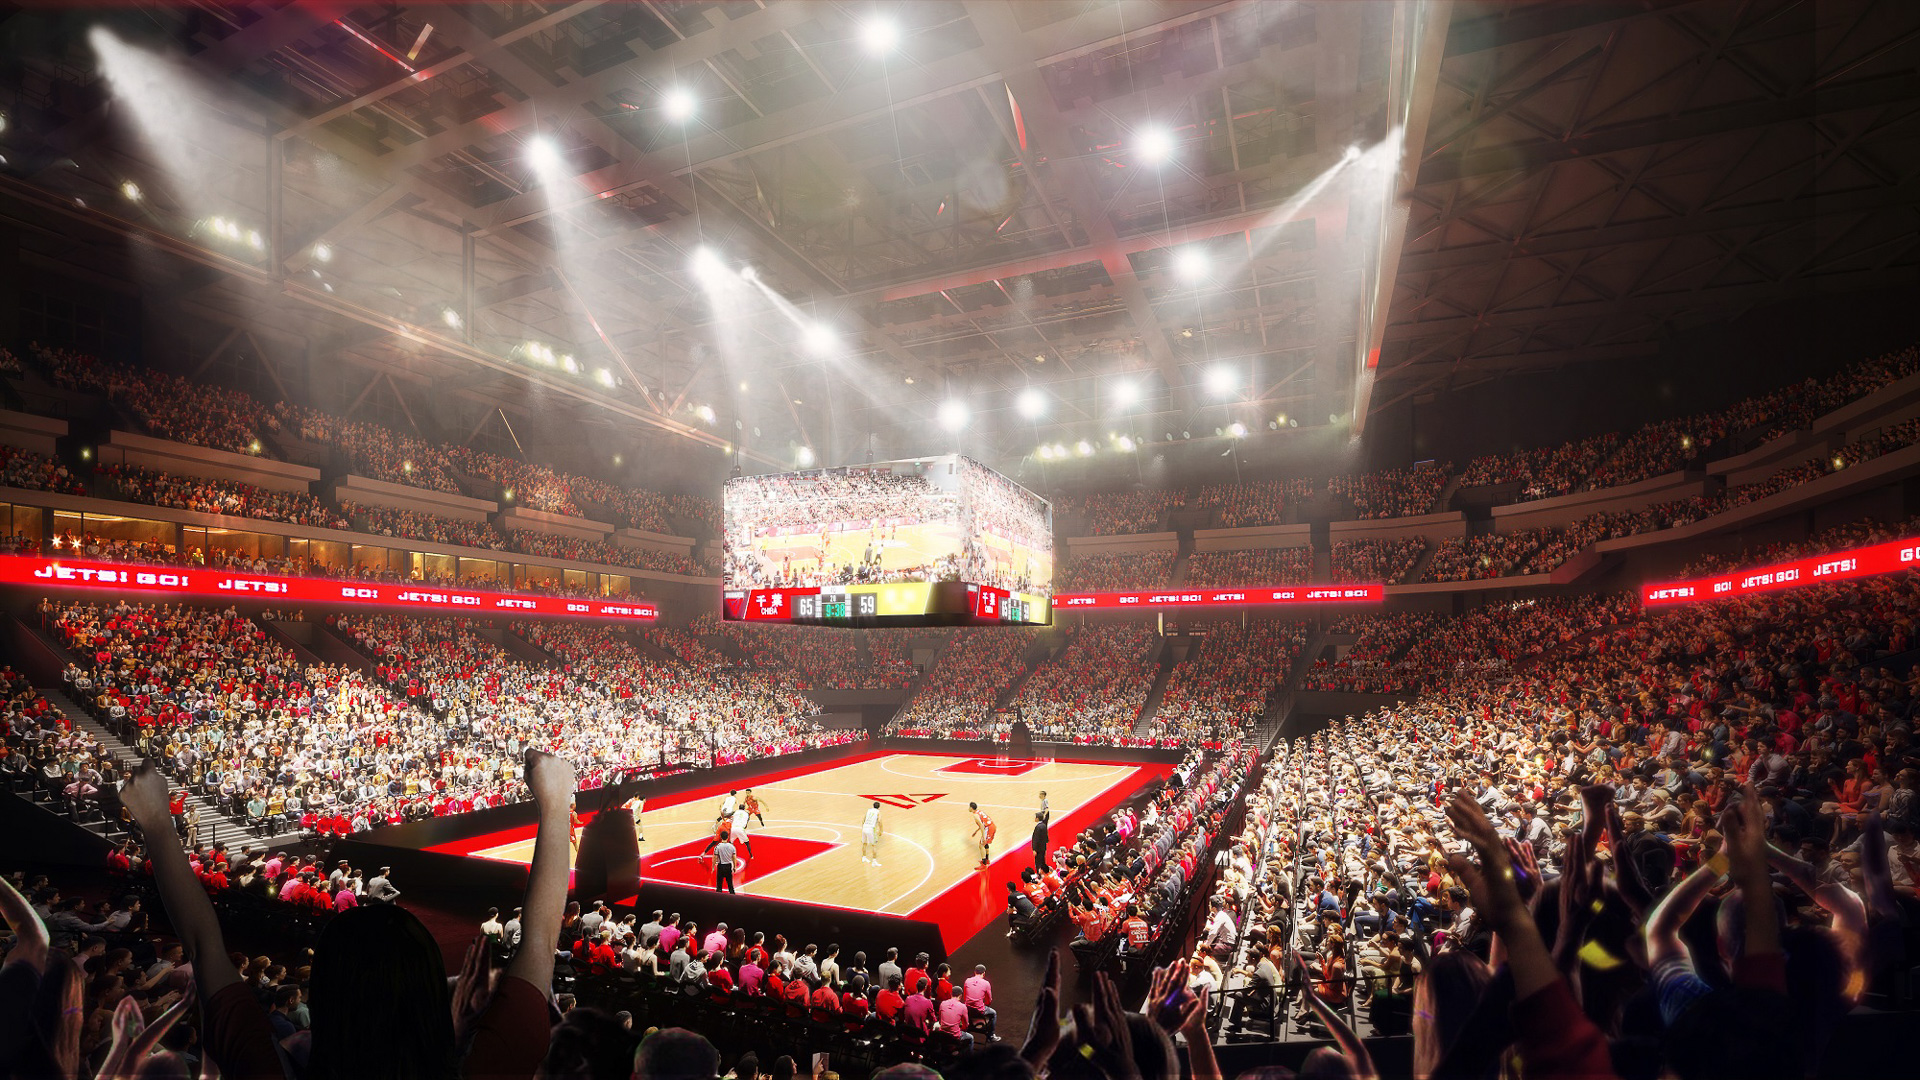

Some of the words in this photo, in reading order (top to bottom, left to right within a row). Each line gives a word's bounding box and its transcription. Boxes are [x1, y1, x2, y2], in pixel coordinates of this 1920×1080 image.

[1649, 587, 1694, 599] JETS!
[1713, 581, 1732, 593] GO!
[1741, 573, 1774, 589] JETS!
[1776, 568, 1800, 583] GO!
[1813, 559, 1857, 577] JETS!
[34, 564, 128, 583] JETS!
[136, 572, 189, 587] GO!
[218, 579, 288, 593] JETS!
[341, 587, 378, 599] GO!
[398, 591, 448, 603] JETS!
[452, 595, 481, 606] GO!
[496, 598, 537, 609] JETS!
[567, 603, 589, 613] GO!
[601, 606, 632, 616] JETS!
[634, 608, 653, 617] GO!
[1067, 597, 1096, 605] JETS!
[1119, 596, 1139, 604] GO!
[1148, 595, 1180, 603] JETS!
[1182, 594, 1202, 602] GO!
[1212, 593, 1245, 601] JETS!
[1272, 592, 1295, 600] GO!
[1307, 590, 1342, 599] JETS!
[1344, 590, 1368, 598] GO!
[756, 593, 783, 607] 千葉
[800, 598, 813, 615] 65
[860, 596, 875, 613] 59
[760, 607, 778, 615] CHIBA
